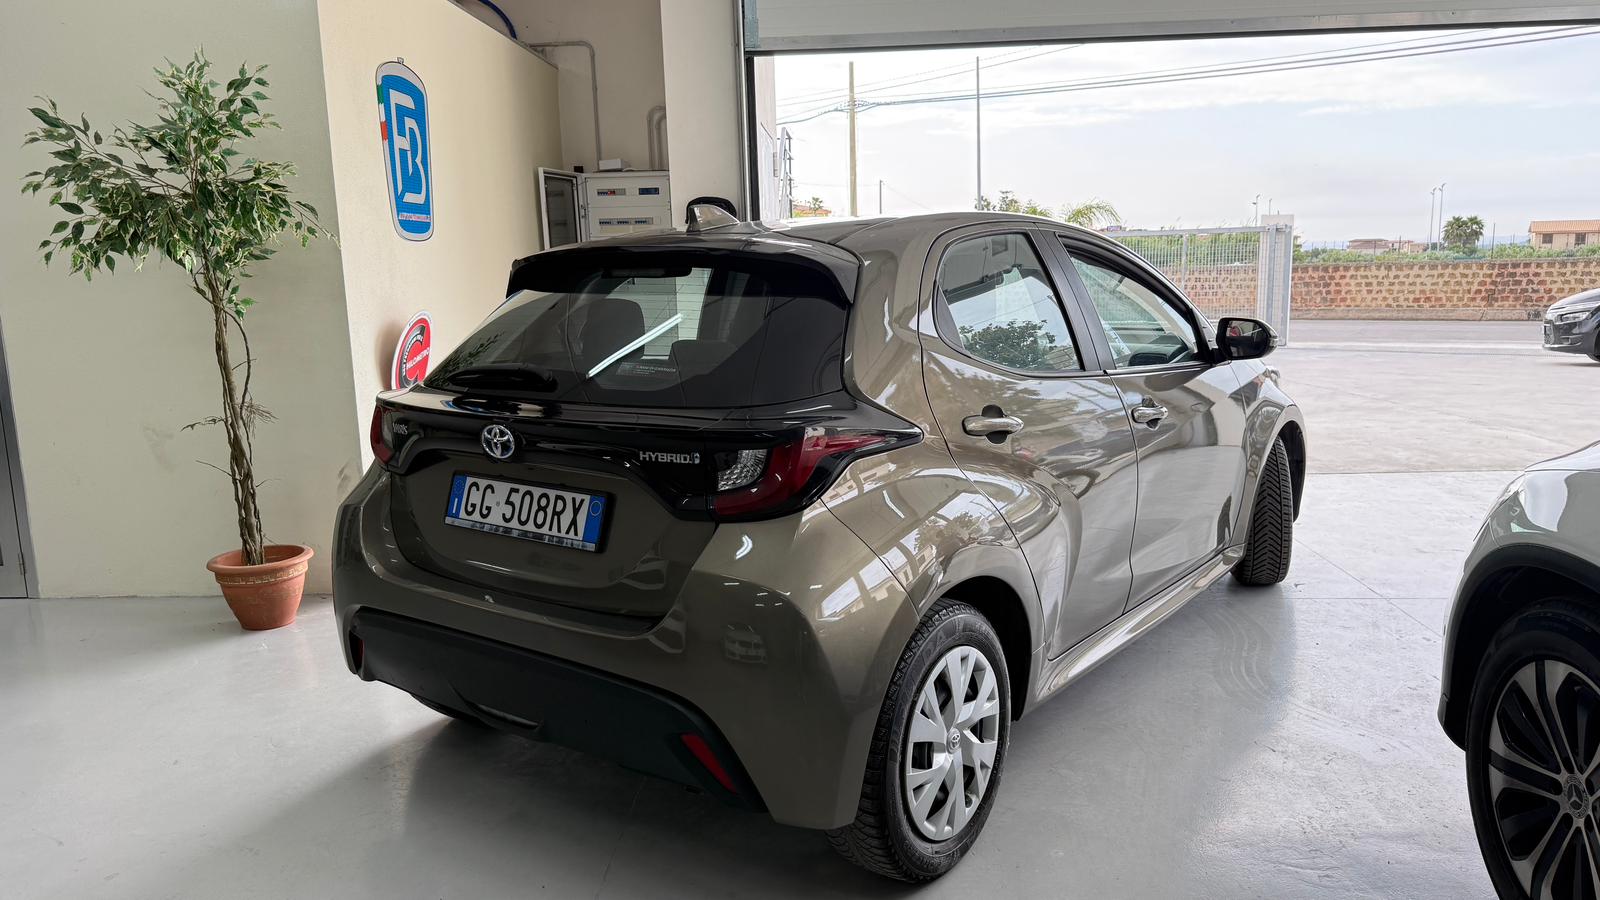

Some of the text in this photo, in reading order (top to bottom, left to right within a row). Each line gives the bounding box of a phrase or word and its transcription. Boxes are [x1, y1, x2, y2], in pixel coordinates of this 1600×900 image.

[639, 451, 691, 464] HYBRID
[464, 481, 495, 519] GG
[502, 487, 586, 537] 508RX
